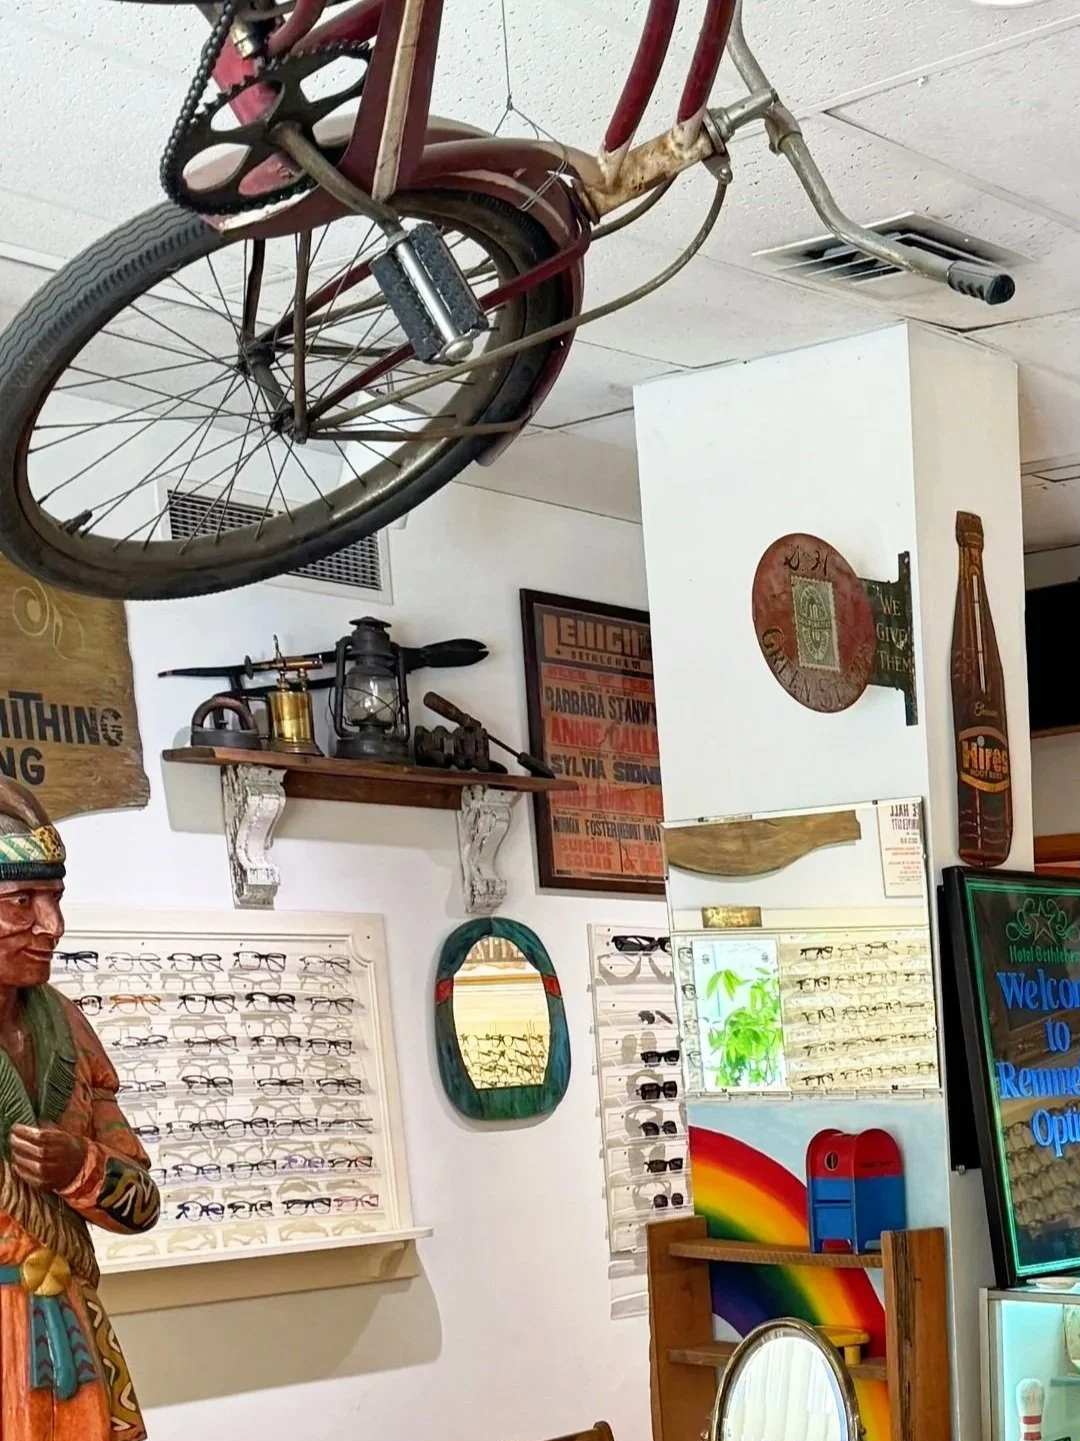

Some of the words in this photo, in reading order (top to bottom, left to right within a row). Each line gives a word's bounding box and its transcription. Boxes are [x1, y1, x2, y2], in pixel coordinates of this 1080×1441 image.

[876, 594, 901, 617] WE
[878, 651, 915, 673] THEM
[543, 685, 606, 719] BARBARA
[550, 752, 607, 780] SYLVIA
[962, 735, 1009, 774] Hires
[585, 819, 617, 839] FOSTER
[1009, 944, 1034, 964] Hotel
[1045, 1019, 1071, 1052] to
